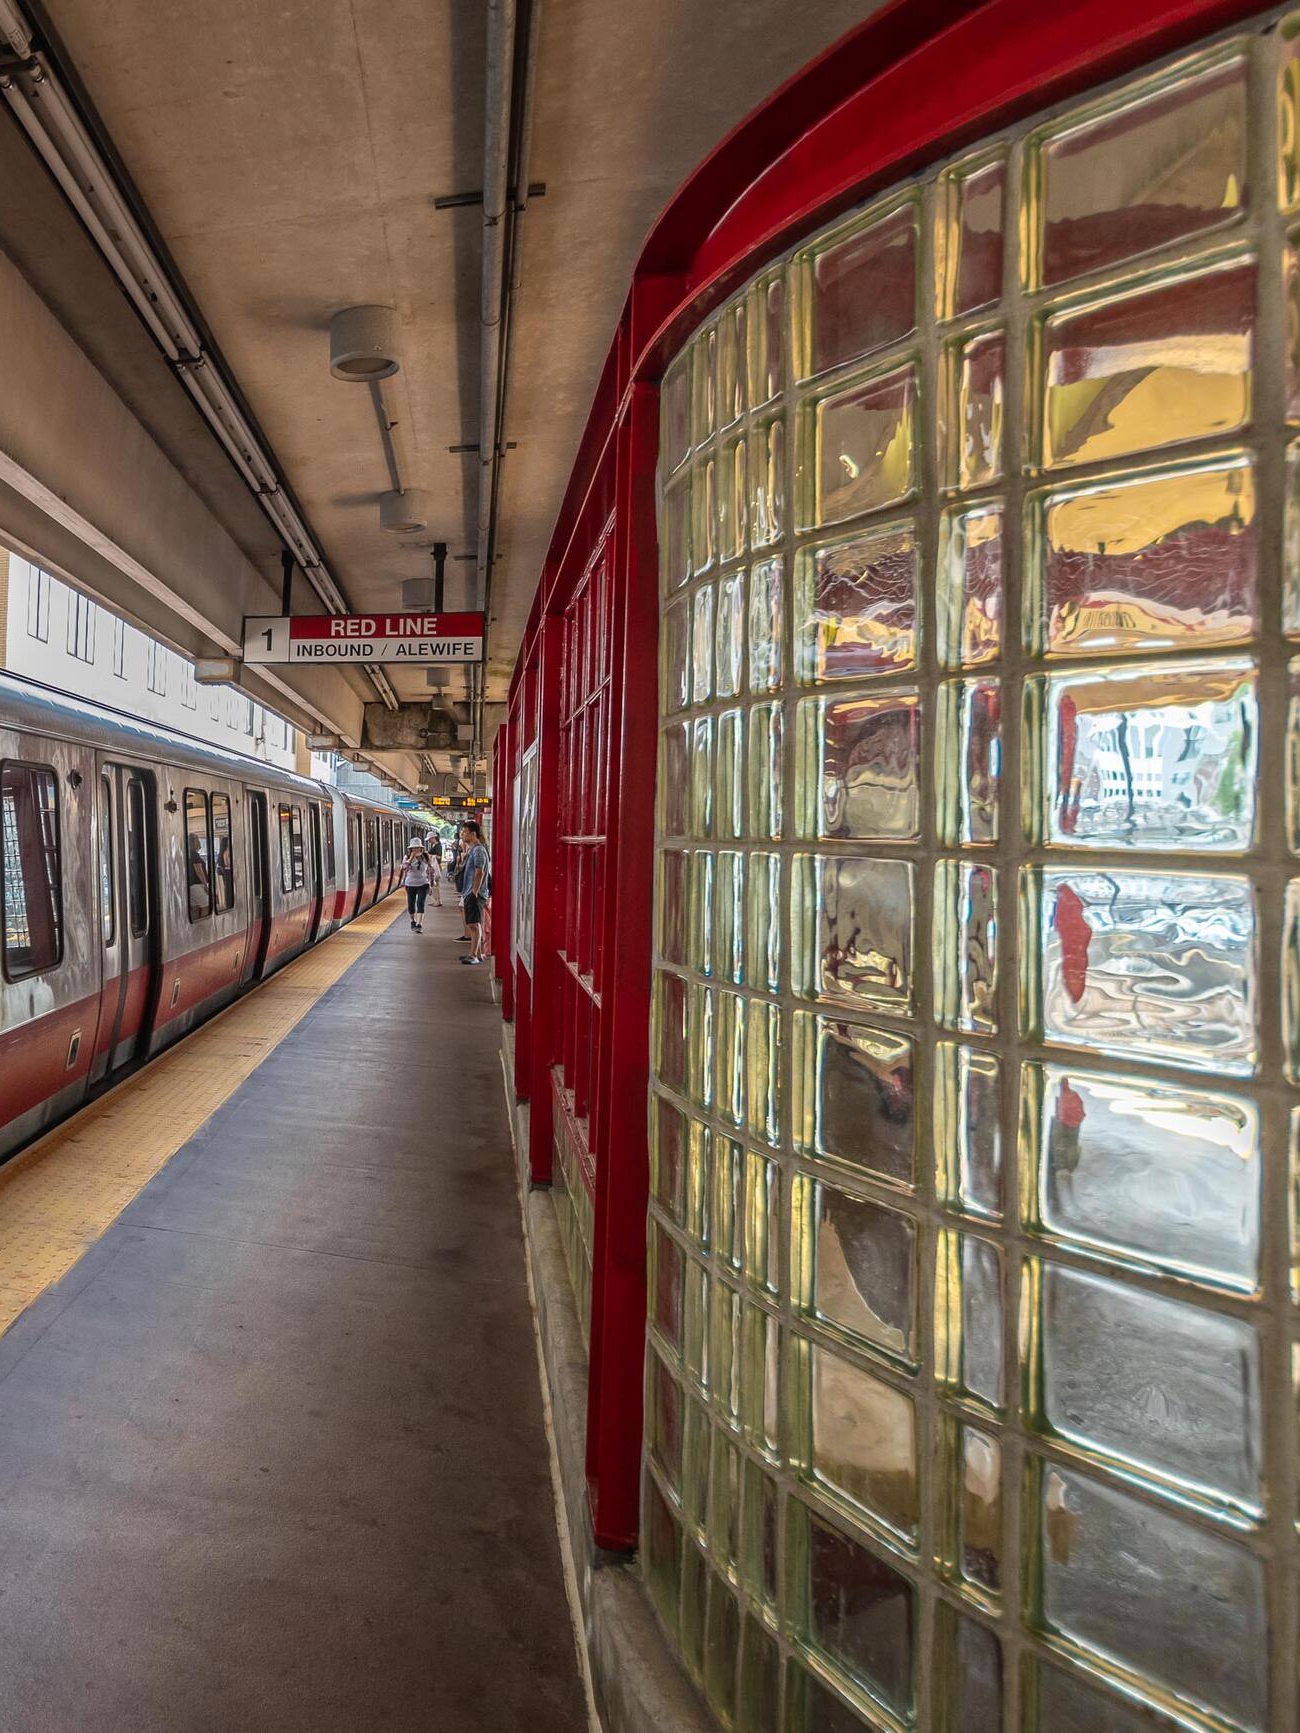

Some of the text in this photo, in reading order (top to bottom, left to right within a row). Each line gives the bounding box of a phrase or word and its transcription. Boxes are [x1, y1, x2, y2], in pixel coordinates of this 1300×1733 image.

[330, 617, 438, 637] RED LINE
[260, 628, 273, 652] 1
[296, 642, 475, 657] INBOUND / ALEWIFE
